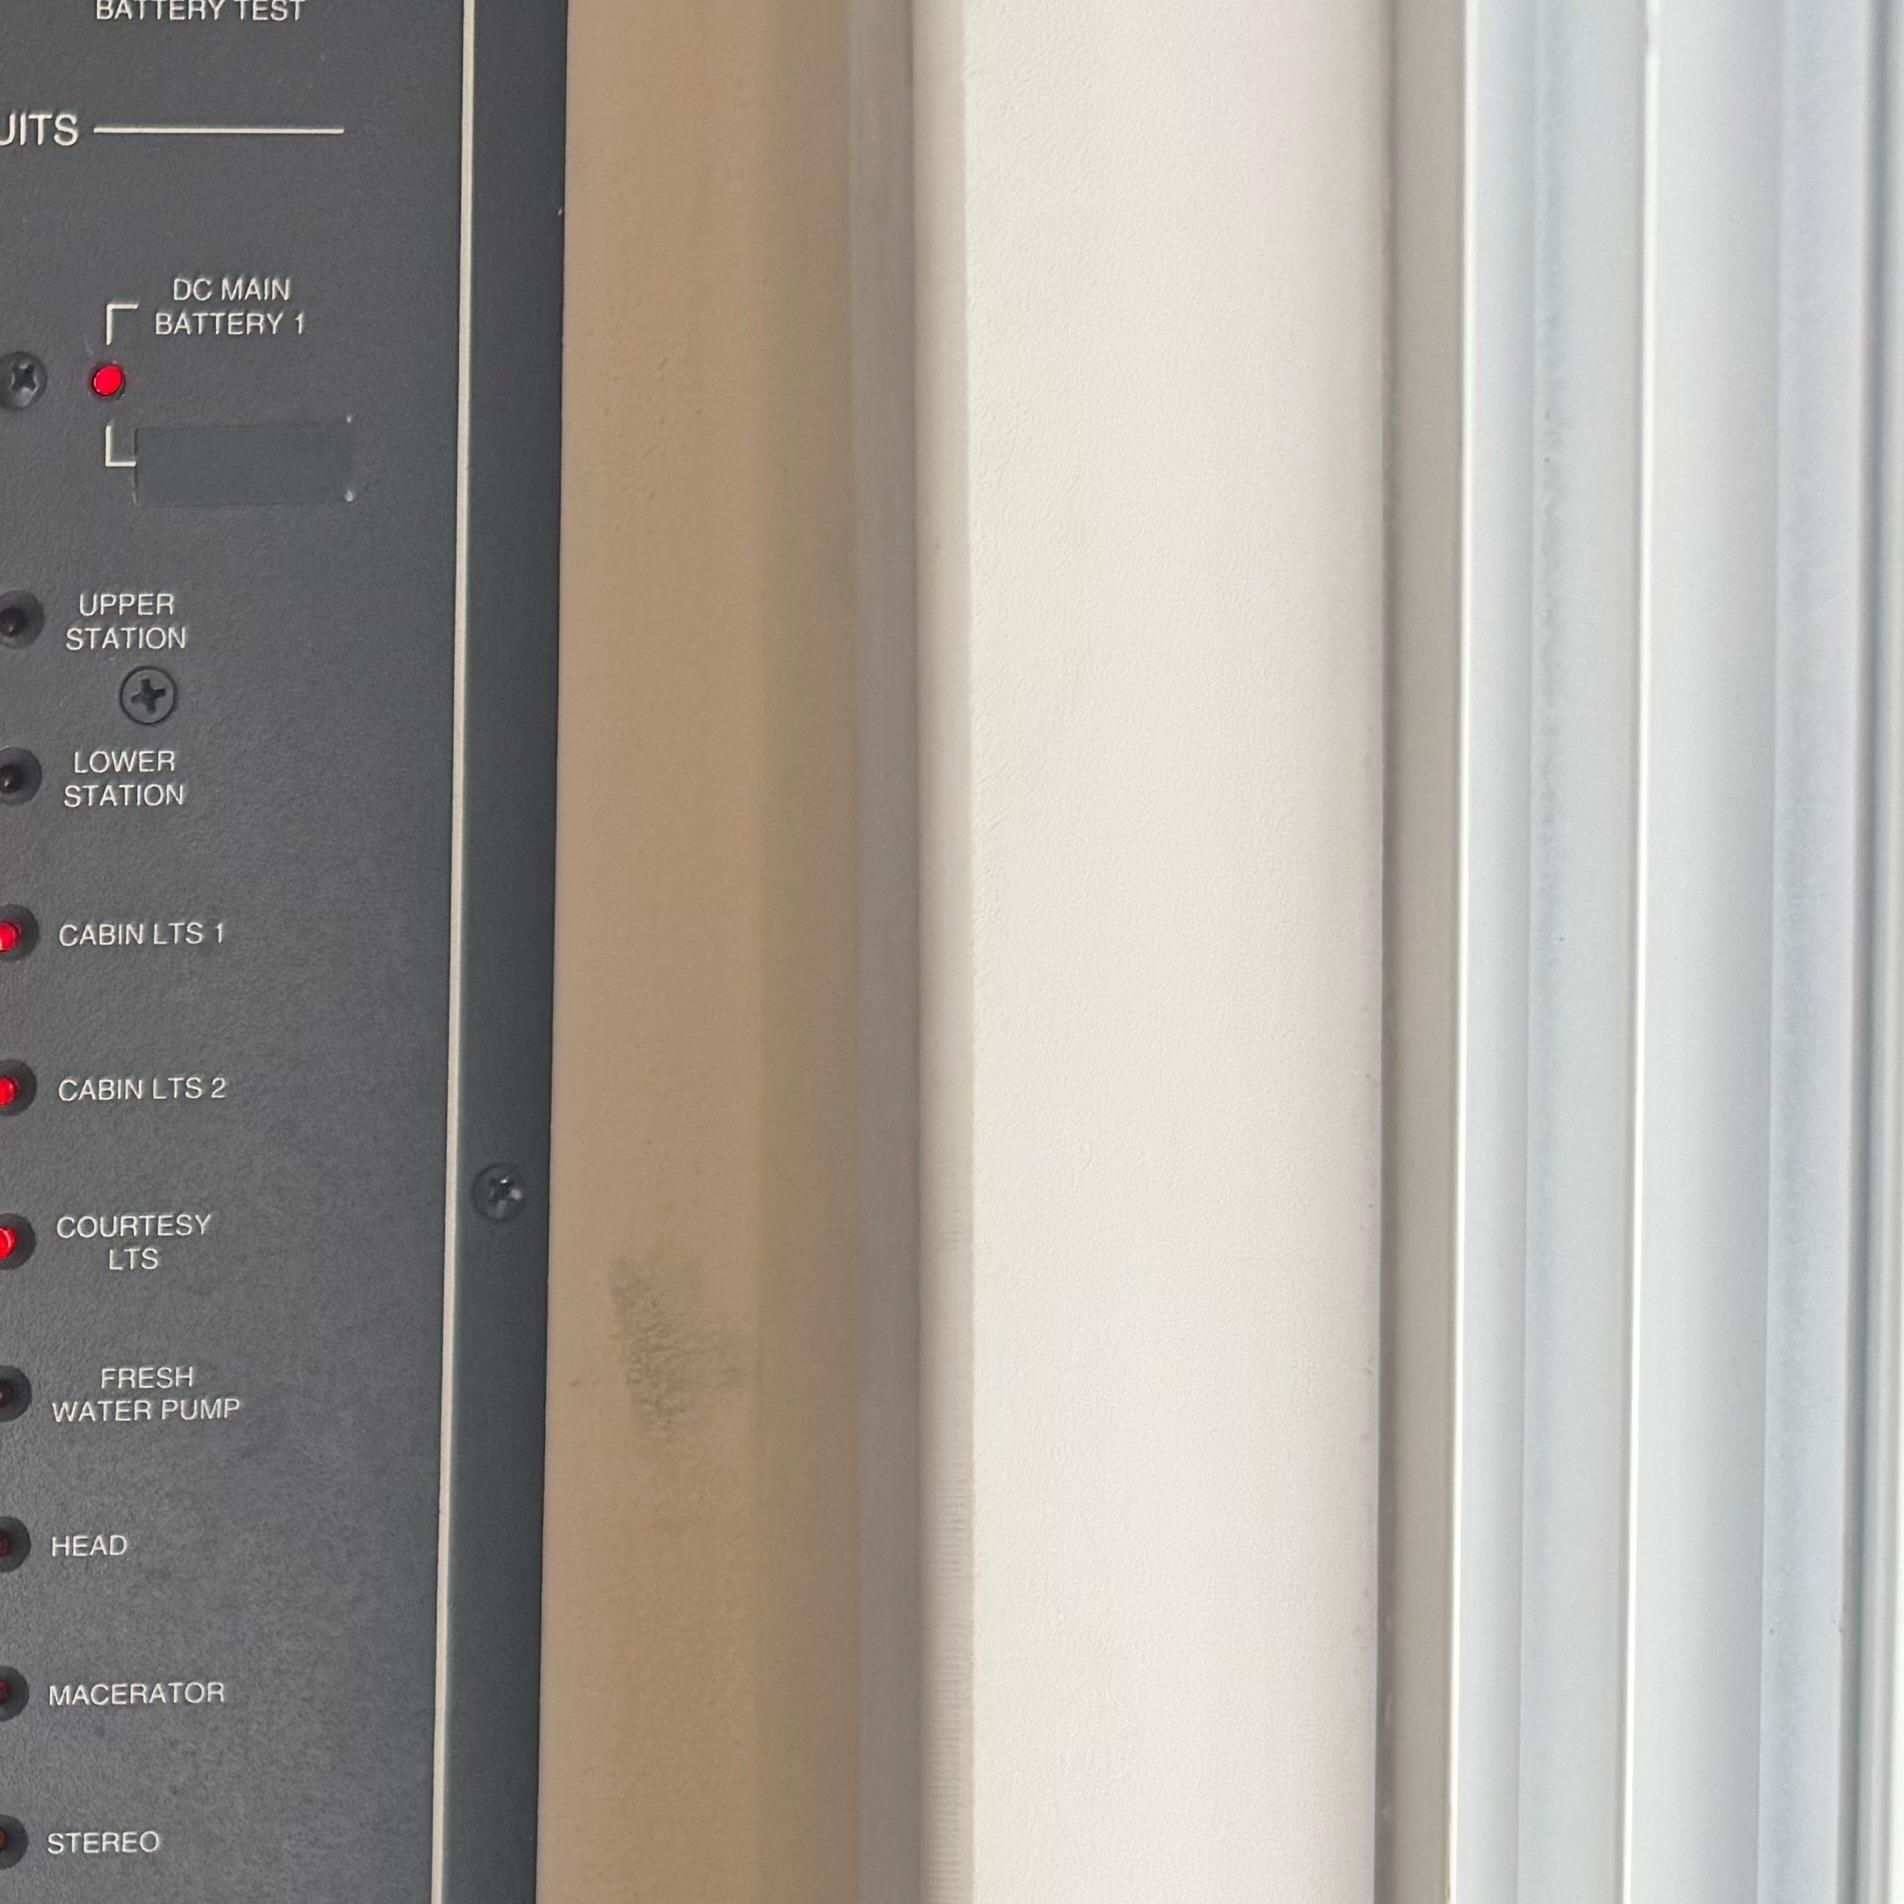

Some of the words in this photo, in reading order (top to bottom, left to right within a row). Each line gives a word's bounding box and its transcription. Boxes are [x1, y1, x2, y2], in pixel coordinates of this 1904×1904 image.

[96, 0, 226, 21] BATTERY
[238, 0, 305, 22] TEST
[173, 277, 213, 301] DC
[221, 277, 291, 301] MAIN
[155, 311, 284, 335] BATTERY
[296, 312, 304, 334] 1
[79, 592, 175, 617] UPPER
[66, 626, 187, 651] STATION
[58, 922, 145, 947] CABIN
[153, 921, 205, 945] LTS
[216, 922, 224, 943] 1
[56, 1213, 212, 1239] COURTESY
[109, 1246, 160, 1271] LTS
[101, 1366, 194, 1389] FRESH
[51, 1399, 152, 1423] WATER
[161, 1397, 241, 1421] PUMP
[51, 1534, 129, 1557] HEAD
[49, 1681, 225, 1706] MACERATOR
[47, 1830, 161, 1855] STEREO
